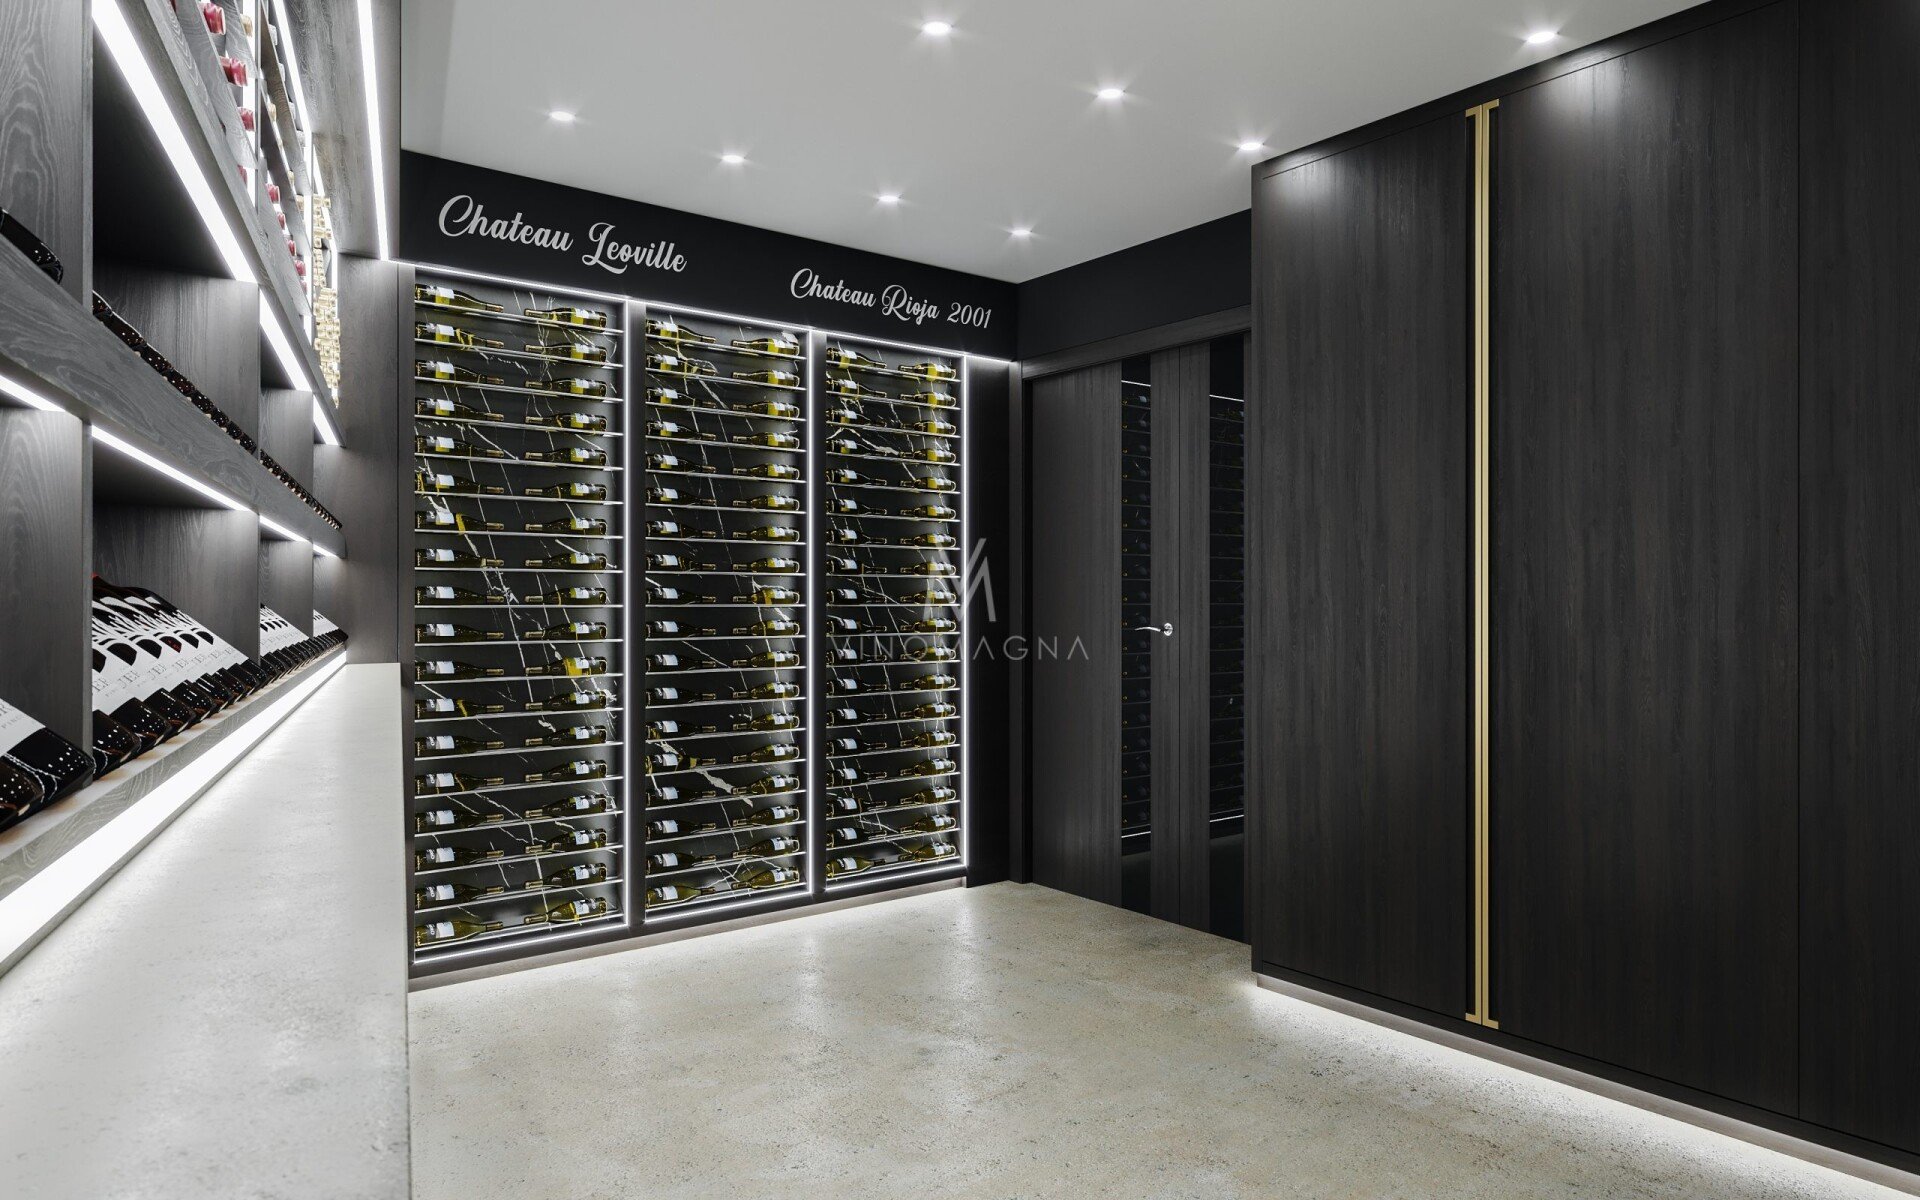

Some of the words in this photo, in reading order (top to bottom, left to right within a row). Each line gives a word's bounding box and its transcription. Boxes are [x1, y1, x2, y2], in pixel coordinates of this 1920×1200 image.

[438, 194, 573, 252] Chateau
[582, 222, 688, 275] Leoville
[791, 268, 877, 308] Chateau
[882, 285, 940, 326] Rioja
[947, 303, 992, 329] 2001
